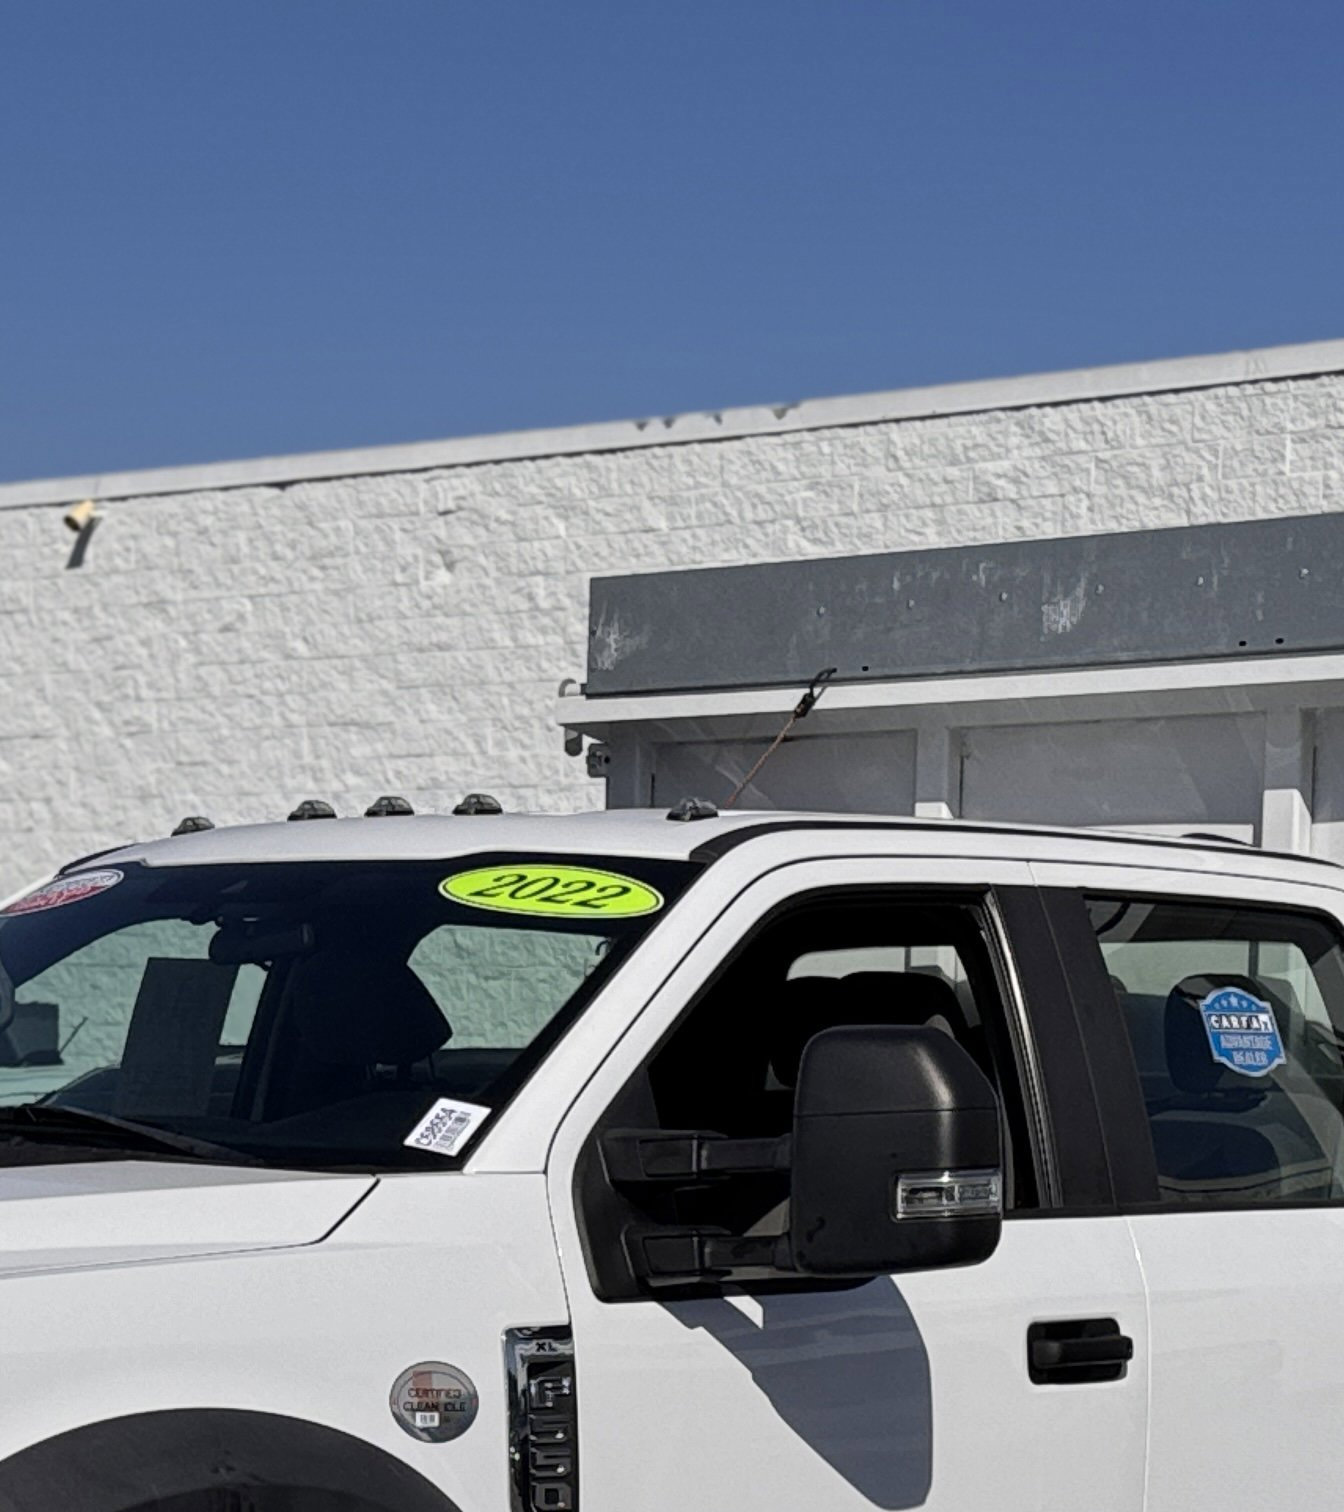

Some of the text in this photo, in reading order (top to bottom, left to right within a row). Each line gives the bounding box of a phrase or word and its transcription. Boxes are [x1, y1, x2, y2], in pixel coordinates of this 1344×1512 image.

[467, 873, 632, 910] 2022
[535, 1341, 558, 1353] XL
[403, 1401, 467, 1412] CLEAN IDLE
